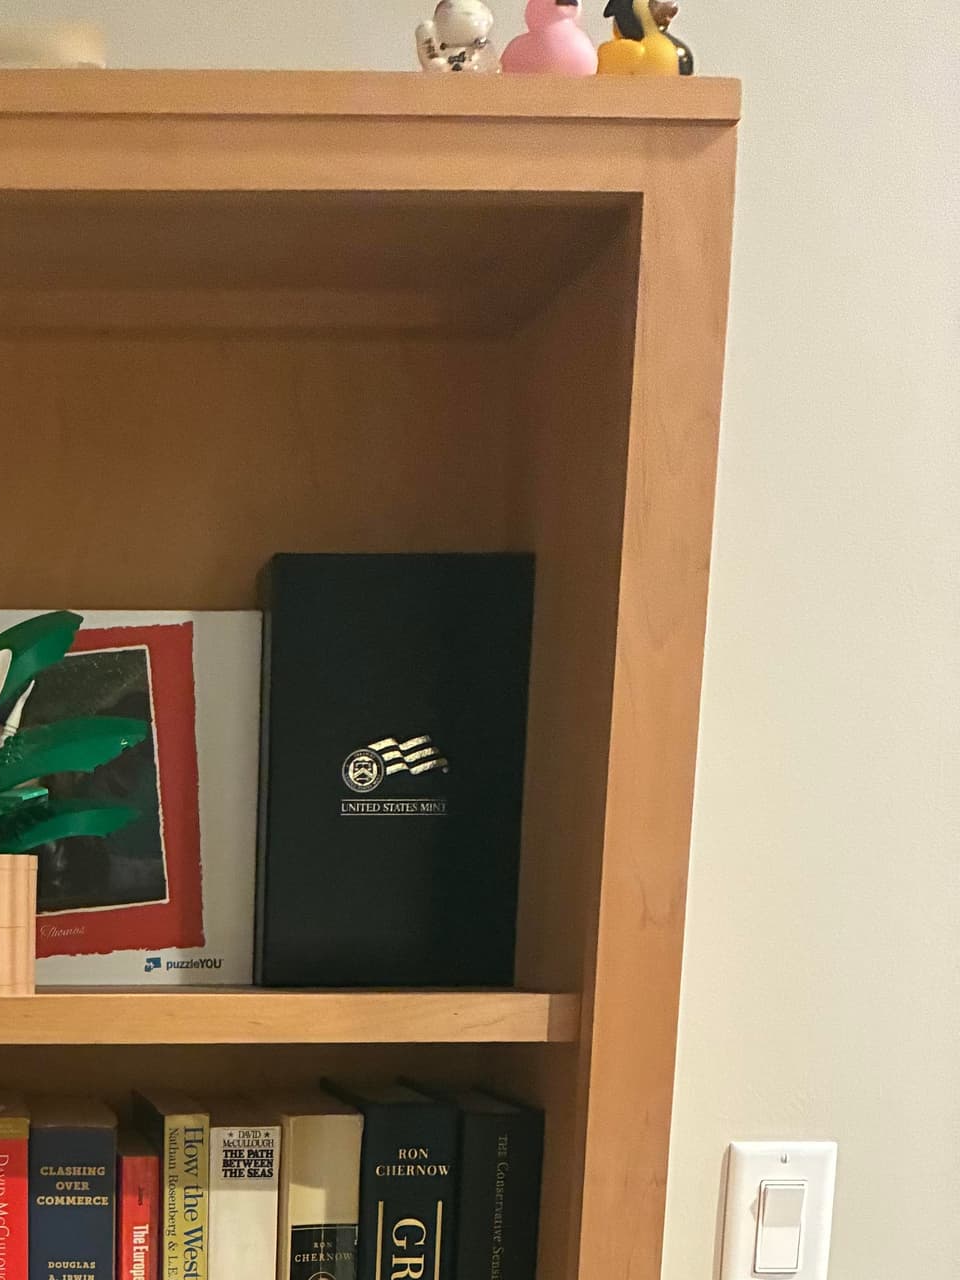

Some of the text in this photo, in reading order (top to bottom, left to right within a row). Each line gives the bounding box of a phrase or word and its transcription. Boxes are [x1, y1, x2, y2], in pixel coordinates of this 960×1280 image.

[341, 803, 446, 812] UNITED STATES MINT
[166, 958, 222, 971] puzzleYOU
[184, 1126, 204, 1179] How
[222, 1149, 273, 1159] THE PATH
[398, 1148, 428, 1159] RON
[222, 1159, 273, 1168] BETWEEN
[40, 1166, 105, 1177] CLASHING
[222, 1168, 273, 1178] THE SEAS
[376, 1165, 450, 1176] CHERNOW
[56, 1182, 89, 1190] OVER
[37, 1196, 108, 1206] COMMERCE
[184, 1184, 203, 1221] the
[132, 1224, 149, 1246] The
